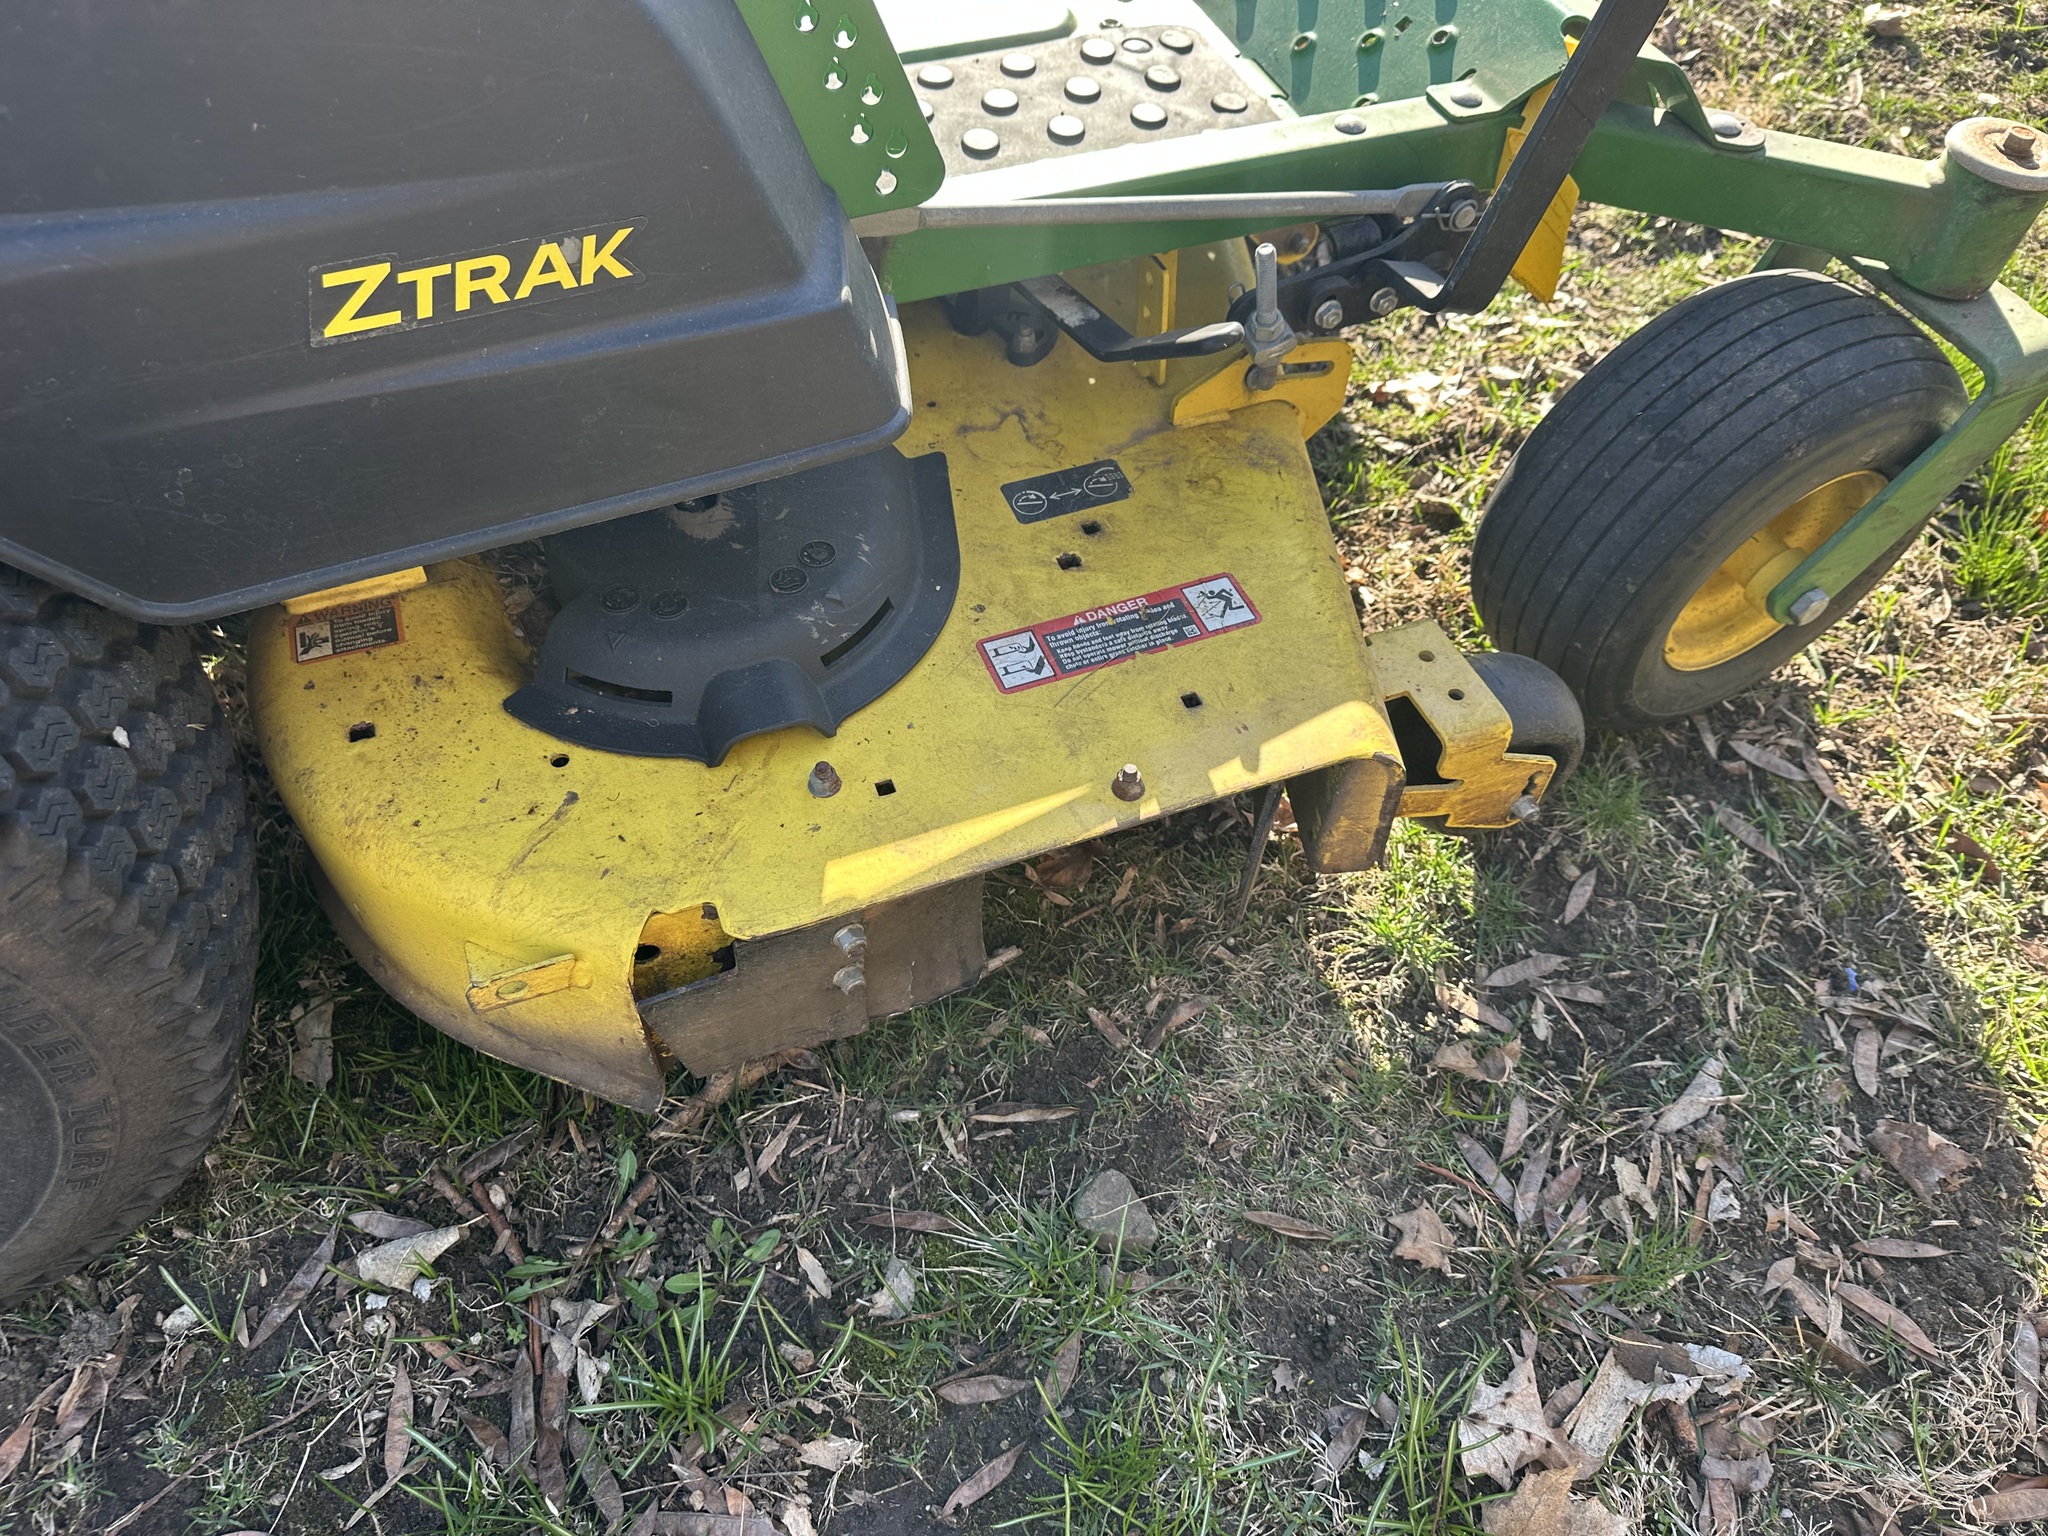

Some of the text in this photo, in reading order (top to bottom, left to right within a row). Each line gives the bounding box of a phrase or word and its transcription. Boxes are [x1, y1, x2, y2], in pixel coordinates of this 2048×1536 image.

[322, 227, 634, 338] ZTRAK
[314, 598, 393, 621] WARNING
[368, 608, 392, 617] injury
[1056, 630, 1076, 640] avoid
[1075, 624, 1096, 634] injury
[1113, 613, 1140, 623] otating
[1162, 602, 1175, 610] and
[1085, 597, 1149, 621] DANGER
[366, 627, 392, 637] before
[1049, 630, 1102, 648] thrown objects:
[1056, 646, 1072, 654] Keep
[1072, 640, 1091, 649] hands
[1090, 637, 1102, 645] and
[1102, 633, 1115, 641] feet
[1115, 630, 1130, 638] away
[1130, 626, 1144, 634] from
[1060, 651, 1075, 659] Keep
[1075, 642, 1108, 655] bystanders
[1113, 635, 1127, 643] safe
[1065, 661, 1082, 670] chute
[1082, 657, 1090, 665] or
[1090, 652, 1108, 663] entire
[1126, 643, 1148, 653] catcher
[1072, 654, 1082, 662] not
[1083, 649, 1106, 660] operate
[1106, 643, 1127, 652] mower
[1149, 629, 1179, 640] discharge
